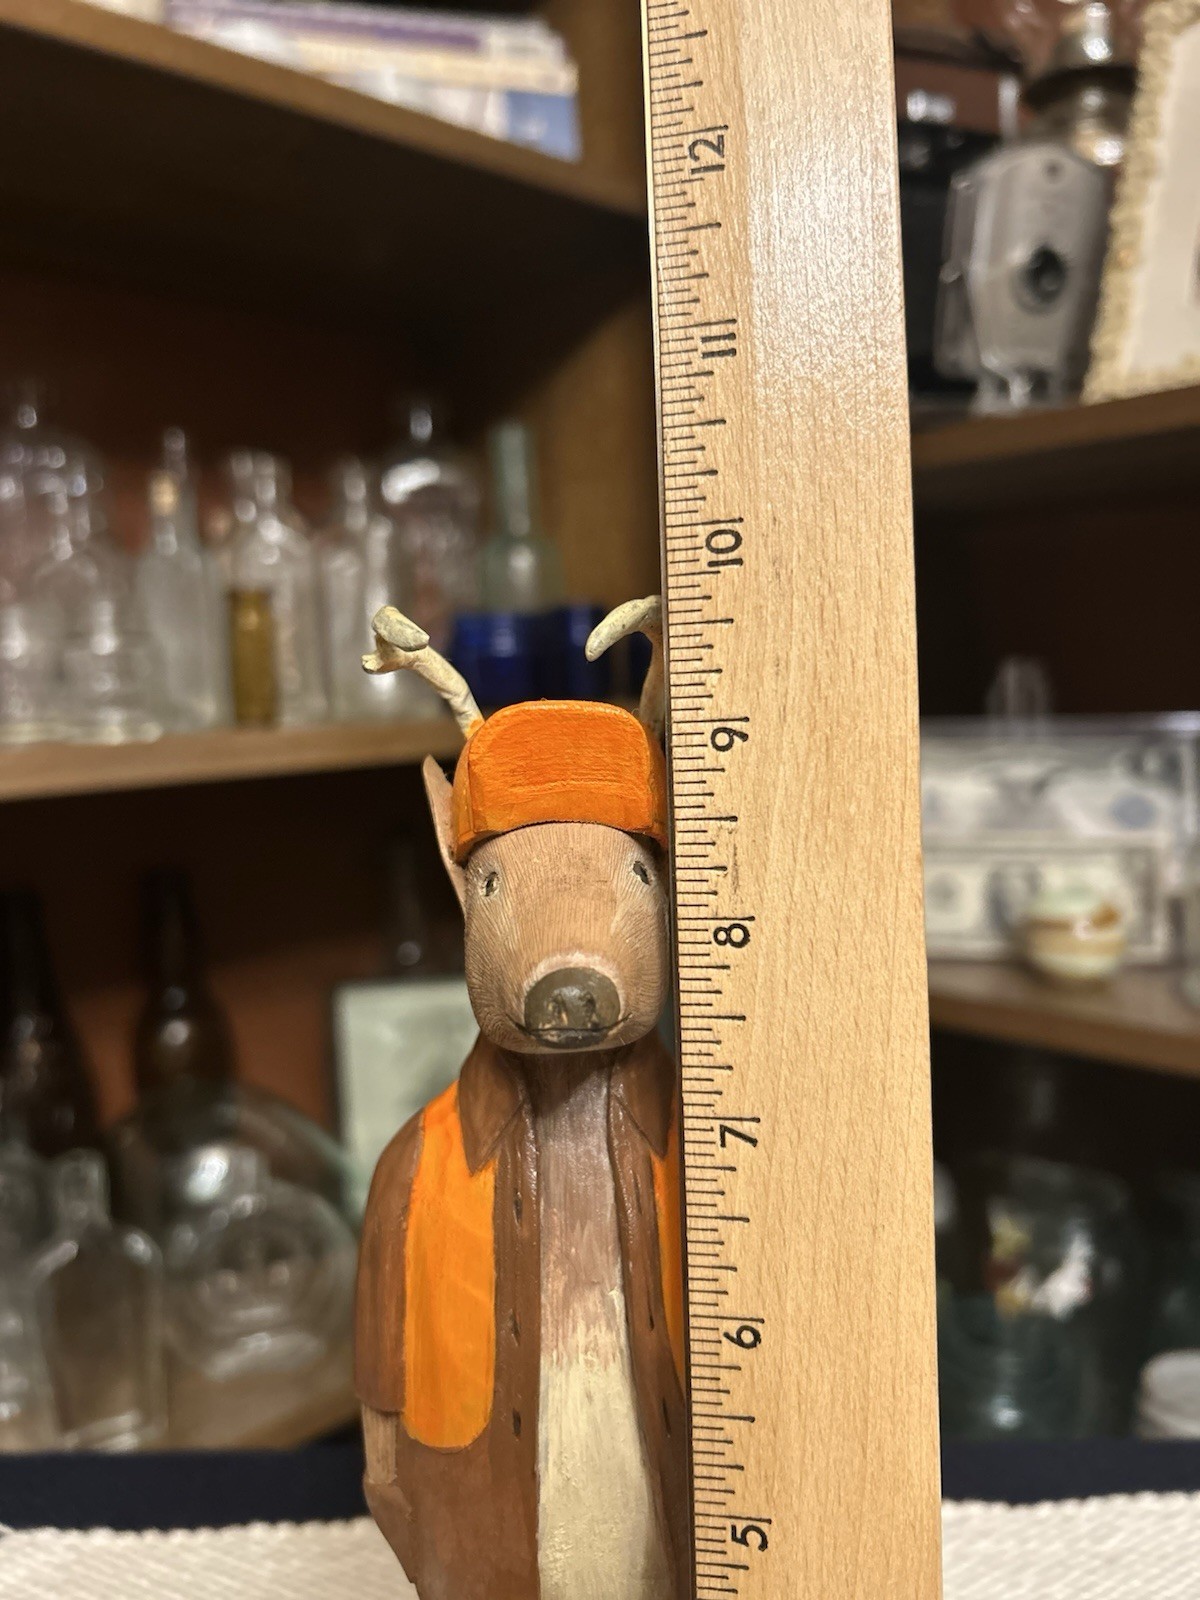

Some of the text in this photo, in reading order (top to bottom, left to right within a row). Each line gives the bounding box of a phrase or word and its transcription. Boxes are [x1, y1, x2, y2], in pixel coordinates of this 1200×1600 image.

[688, 134, 725, 175] 12
[700, 332, 737, 359] 11
[705, 528, 744, 568] 10
[710, 727, 749, 752] 9
[713, 923, 751, 948] 8
[719, 1124, 759, 1148] 7
[723, 1324, 762, 1350] 6
[730, 1524, 768, 1552] 5
